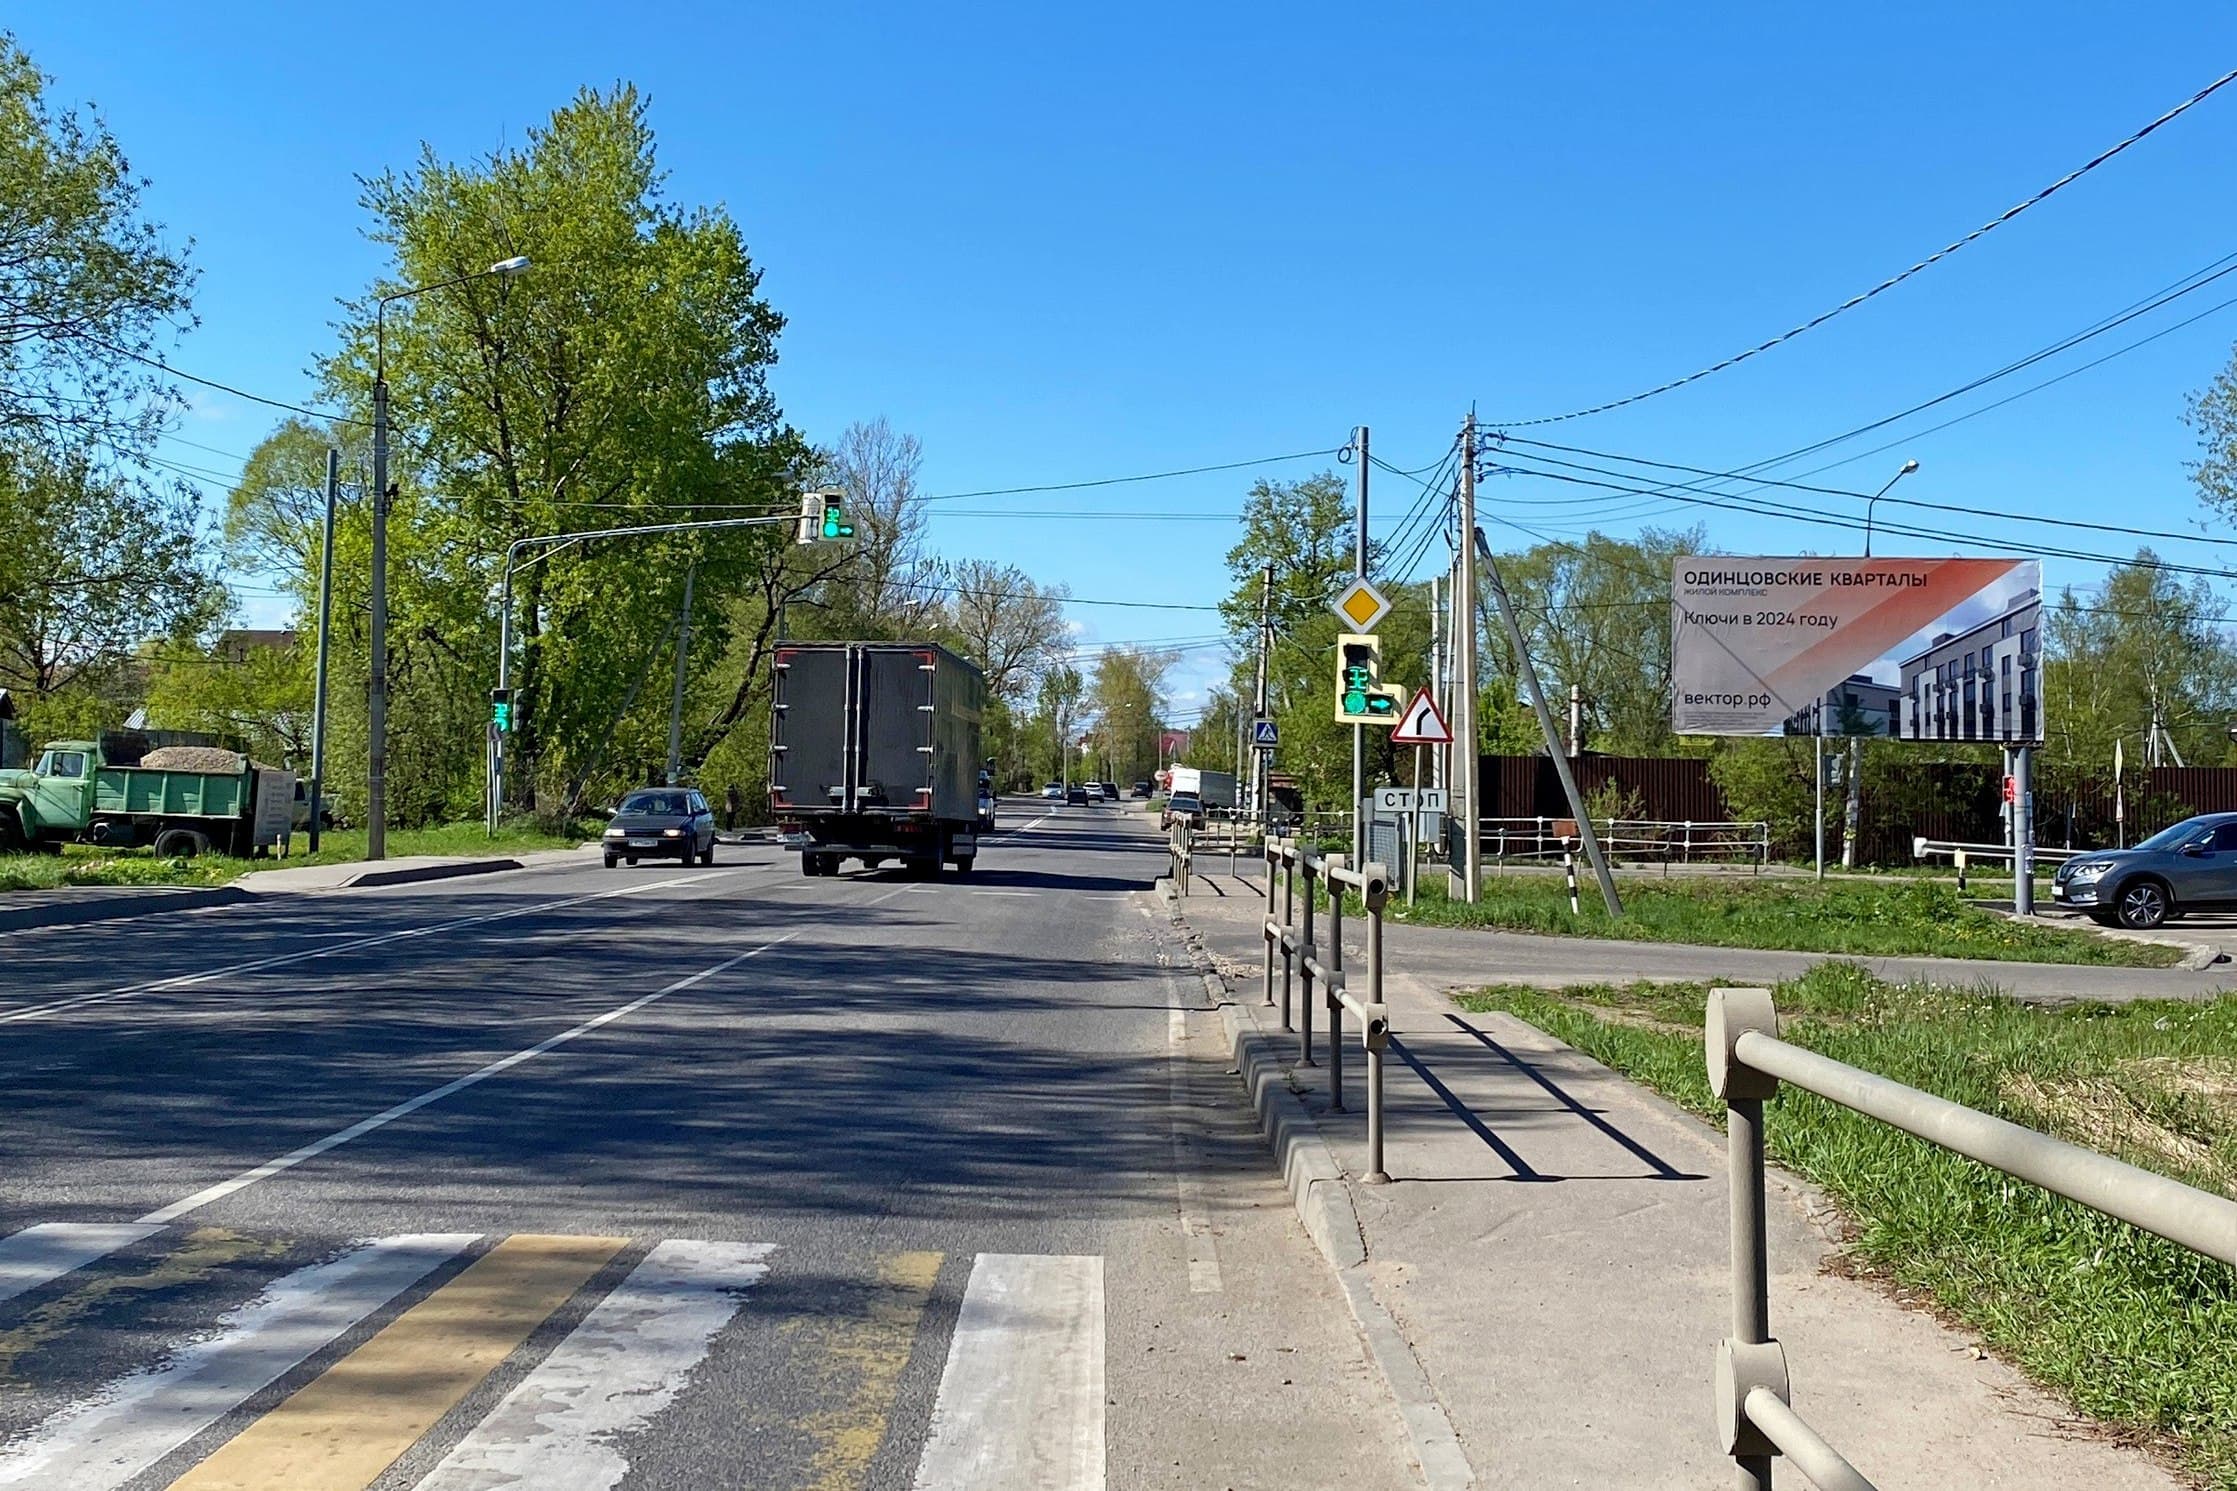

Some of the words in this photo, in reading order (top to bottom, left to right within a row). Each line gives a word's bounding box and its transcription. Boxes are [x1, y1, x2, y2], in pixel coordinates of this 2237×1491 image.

[1684, 571, 1823, 587] ОДИНЦОВСКИЕ
[1830, 572, 1928, 588] КВАРТАЛЫ
[1684, 587, 1717, 596] ЖИЛОЙ
[1719, 588, 1769, 597] КОМПЛЕКС
[1684, 611, 1739, 626] Ключи
[1743, 614, 1753, 626] в
[1756, 612, 1796, 626] 2024
[1799, 615, 1838, 630] году
